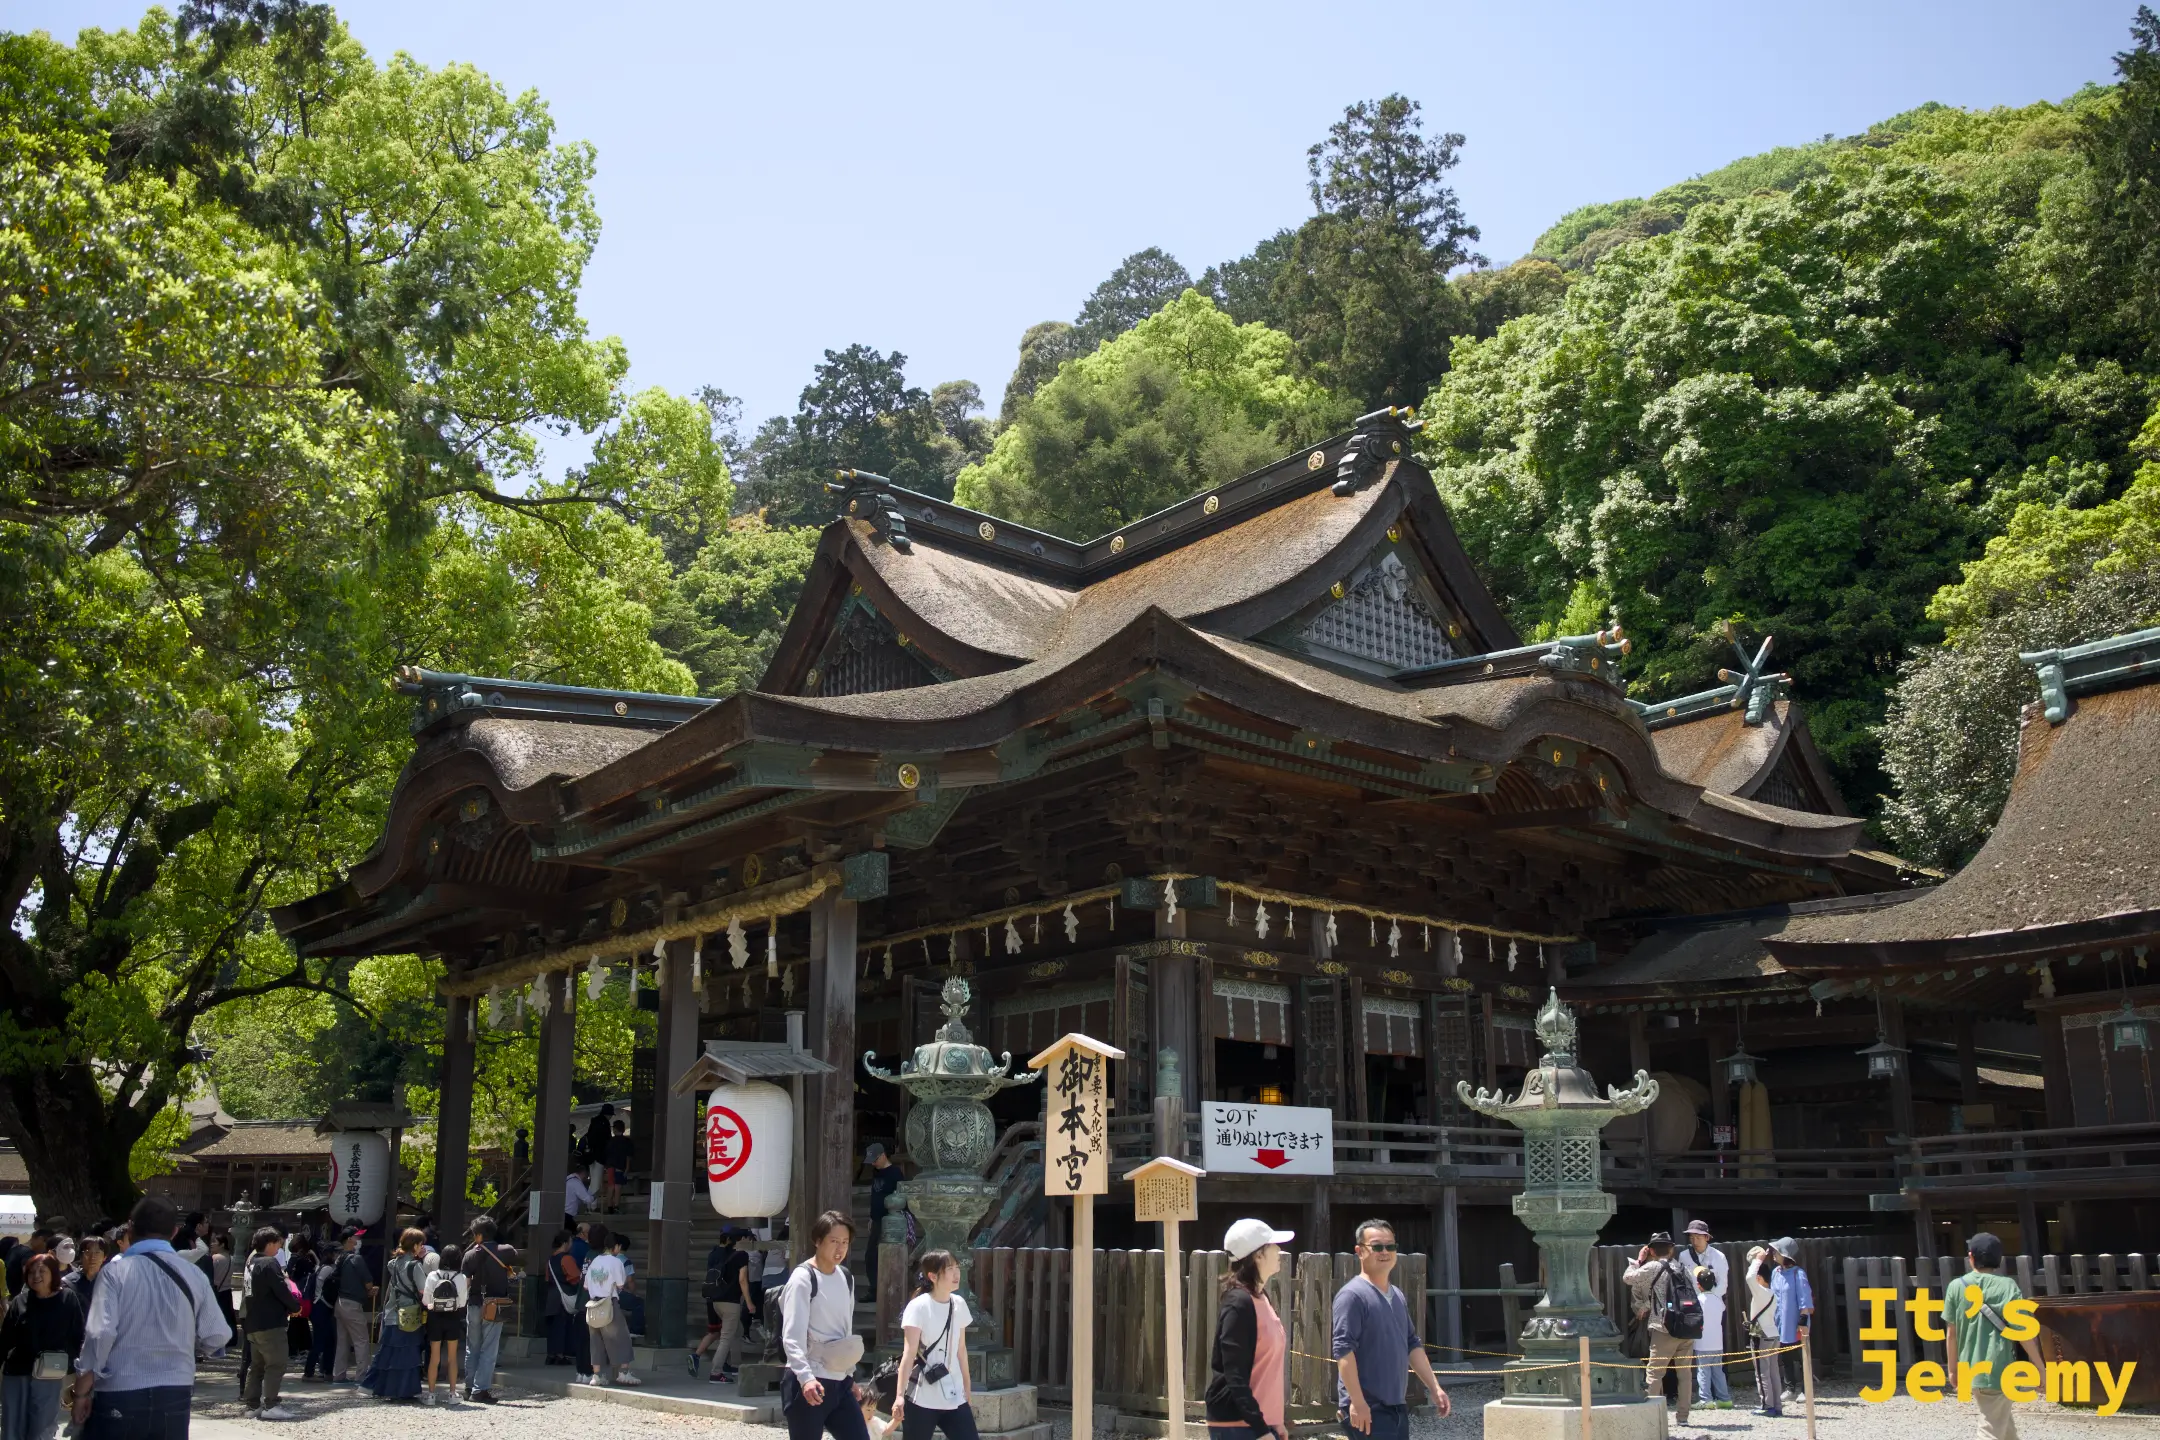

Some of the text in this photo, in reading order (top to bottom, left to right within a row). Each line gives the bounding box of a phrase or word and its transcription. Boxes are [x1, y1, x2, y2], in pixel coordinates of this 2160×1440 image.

[1053, 1047, 1093, 1191] 御本宮
[1089, 1052, 1102, 1155] 重要文化財
[1214, 1108, 1258, 1126] この下
[707, 1116, 738, 1168] 金
[1216, 1128, 1323, 1150] 通りぬけできます
